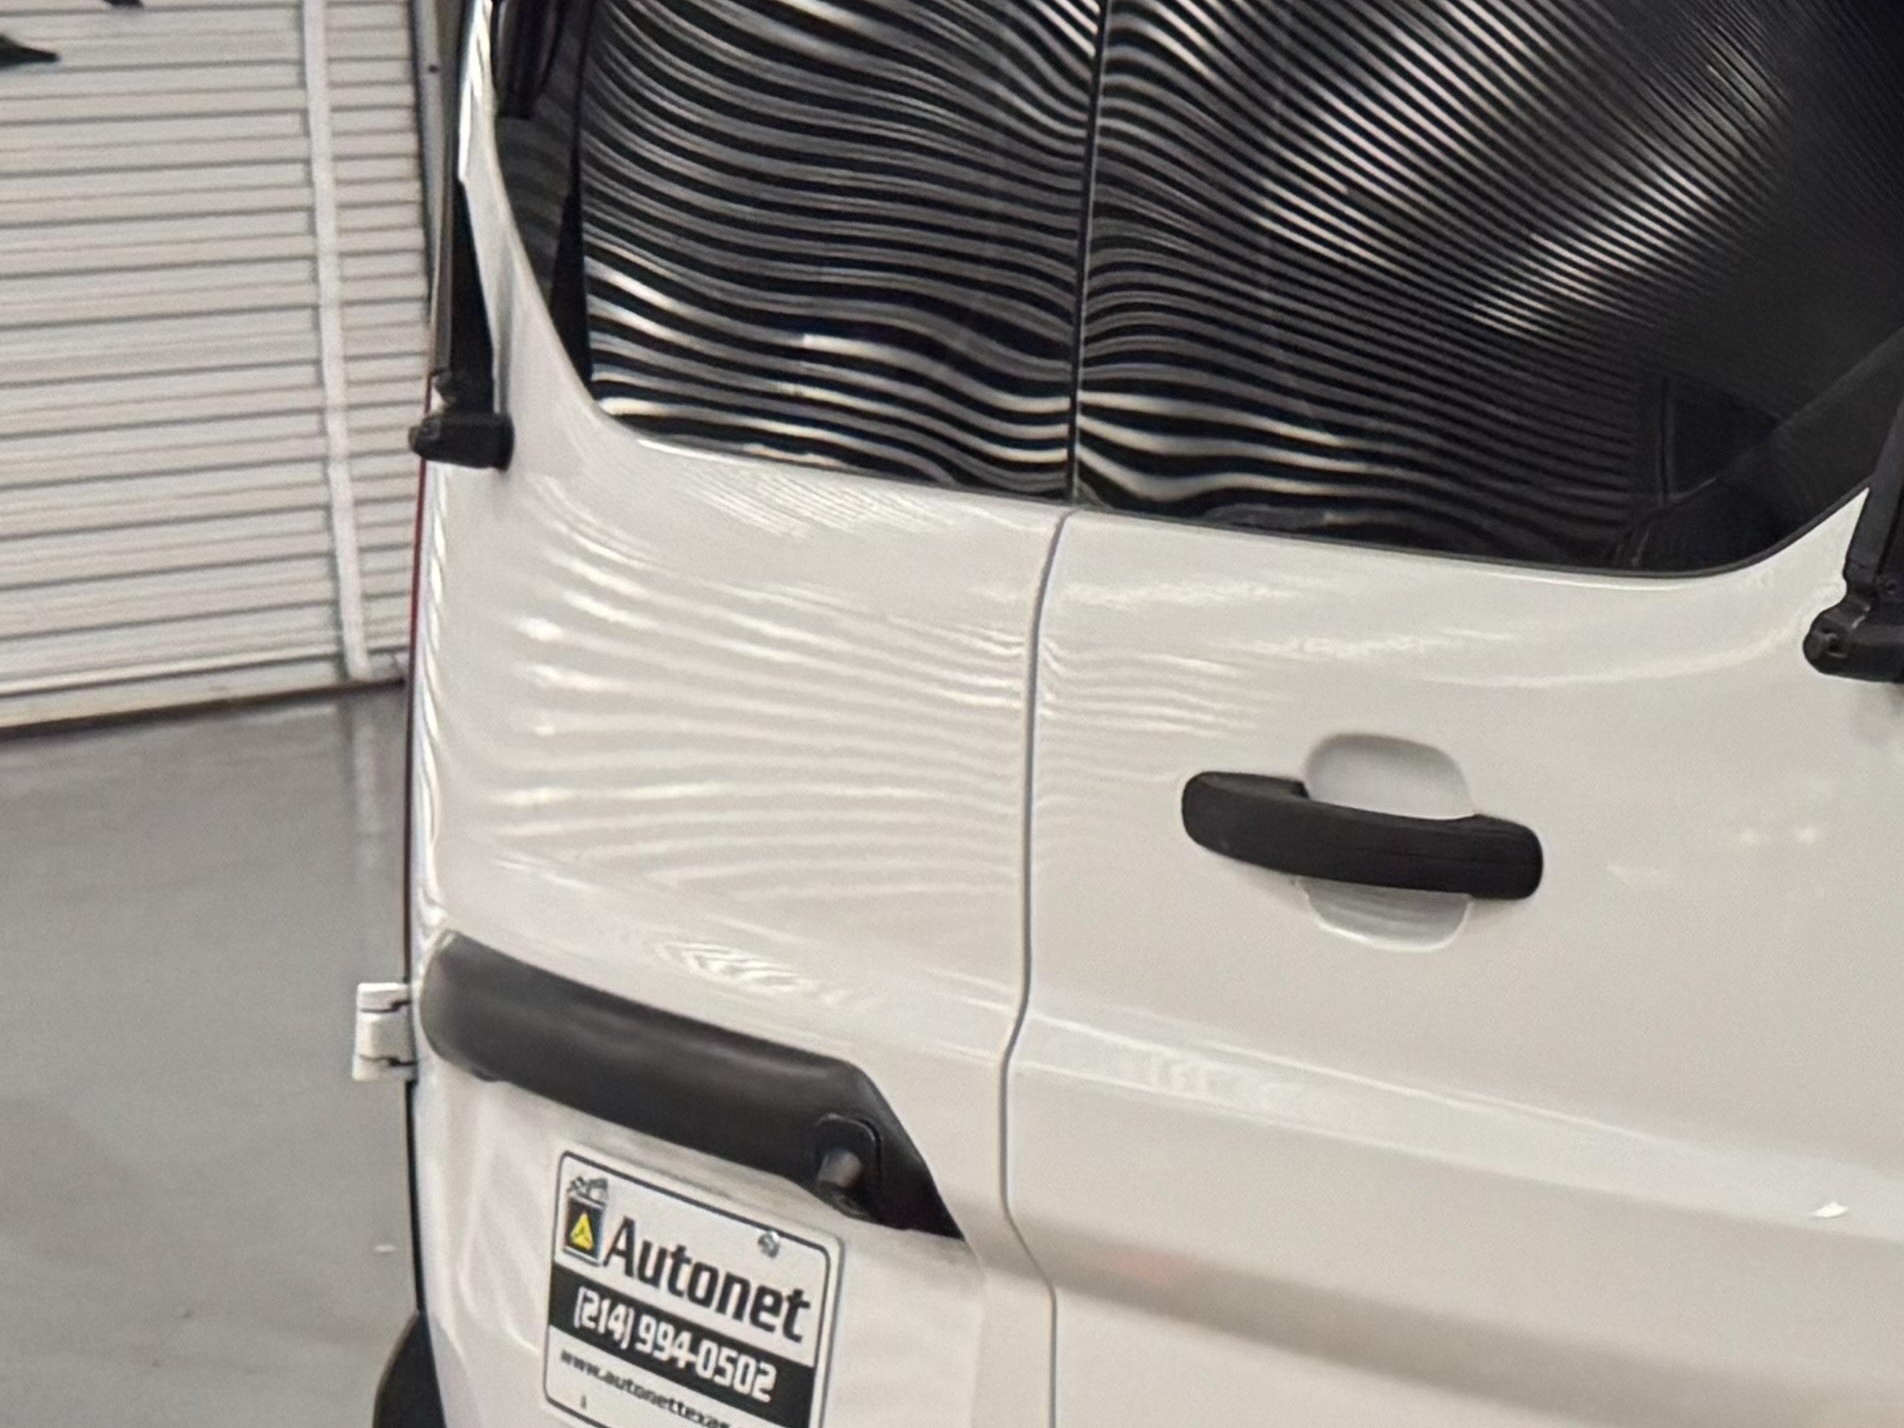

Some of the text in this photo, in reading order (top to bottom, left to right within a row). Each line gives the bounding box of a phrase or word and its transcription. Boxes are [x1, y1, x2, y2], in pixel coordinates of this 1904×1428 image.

[604, 1216, 810, 1342] Autonet
[574, 1286, 777, 1402] (214) 994-0502
